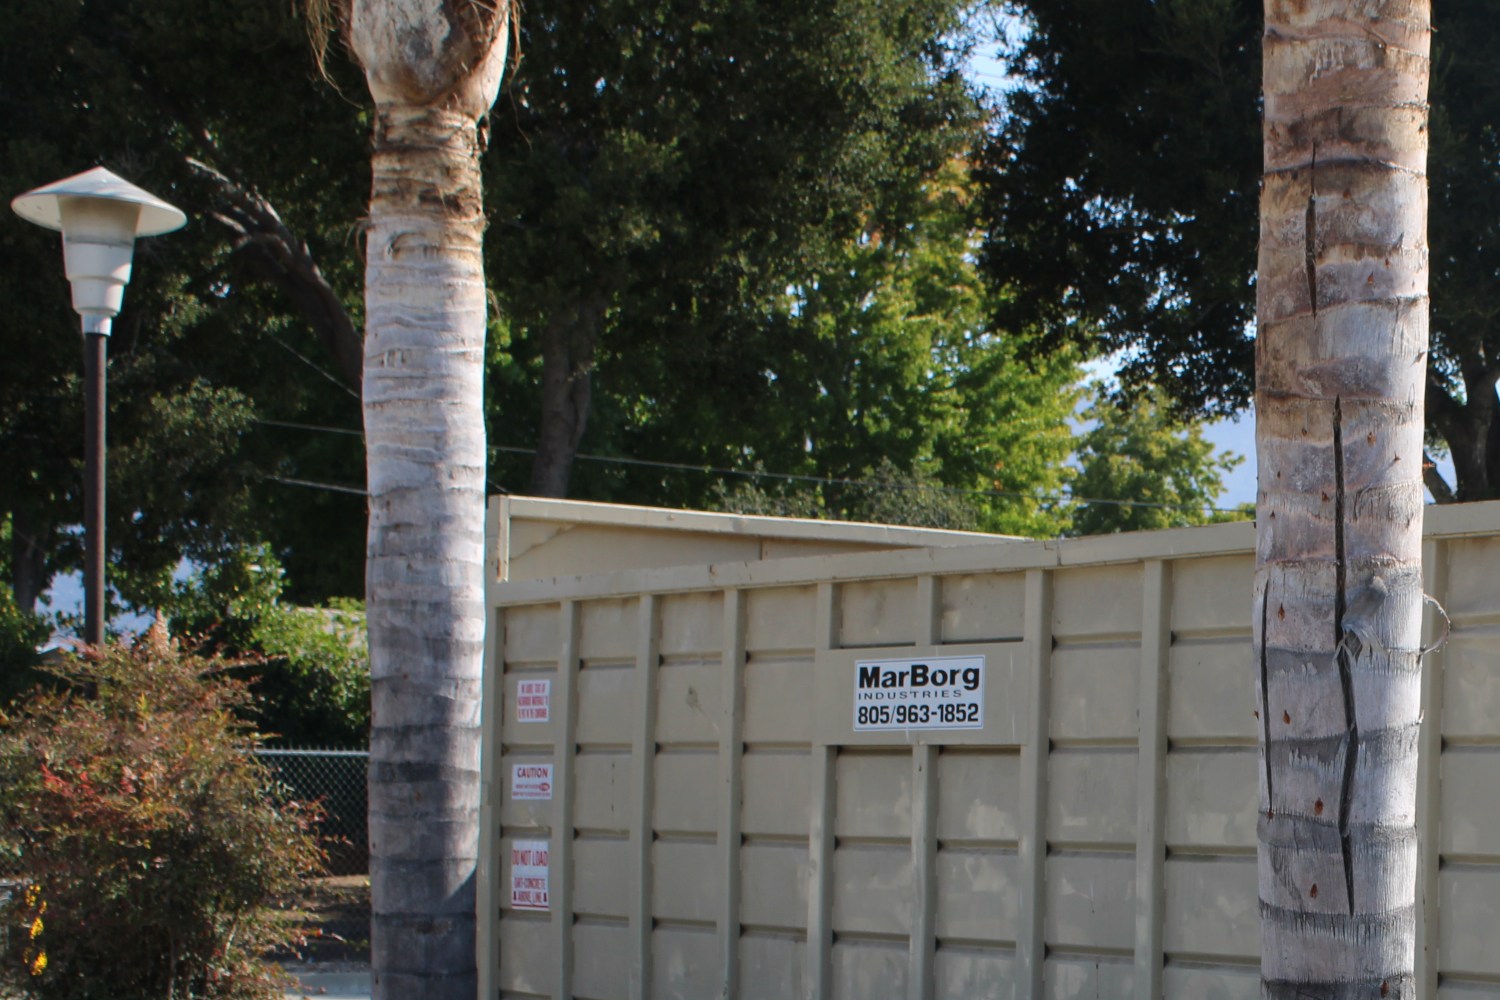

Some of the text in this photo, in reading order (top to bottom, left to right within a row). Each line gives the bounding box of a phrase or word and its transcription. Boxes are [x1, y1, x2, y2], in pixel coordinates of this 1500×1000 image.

[858, 664, 980, 690] MarBorg
[858, 690, 962, 700] INDUSTRIES
[858, 703, 979, 724] 805/963-1852
[517, 767, 549, 779] CAUTION
